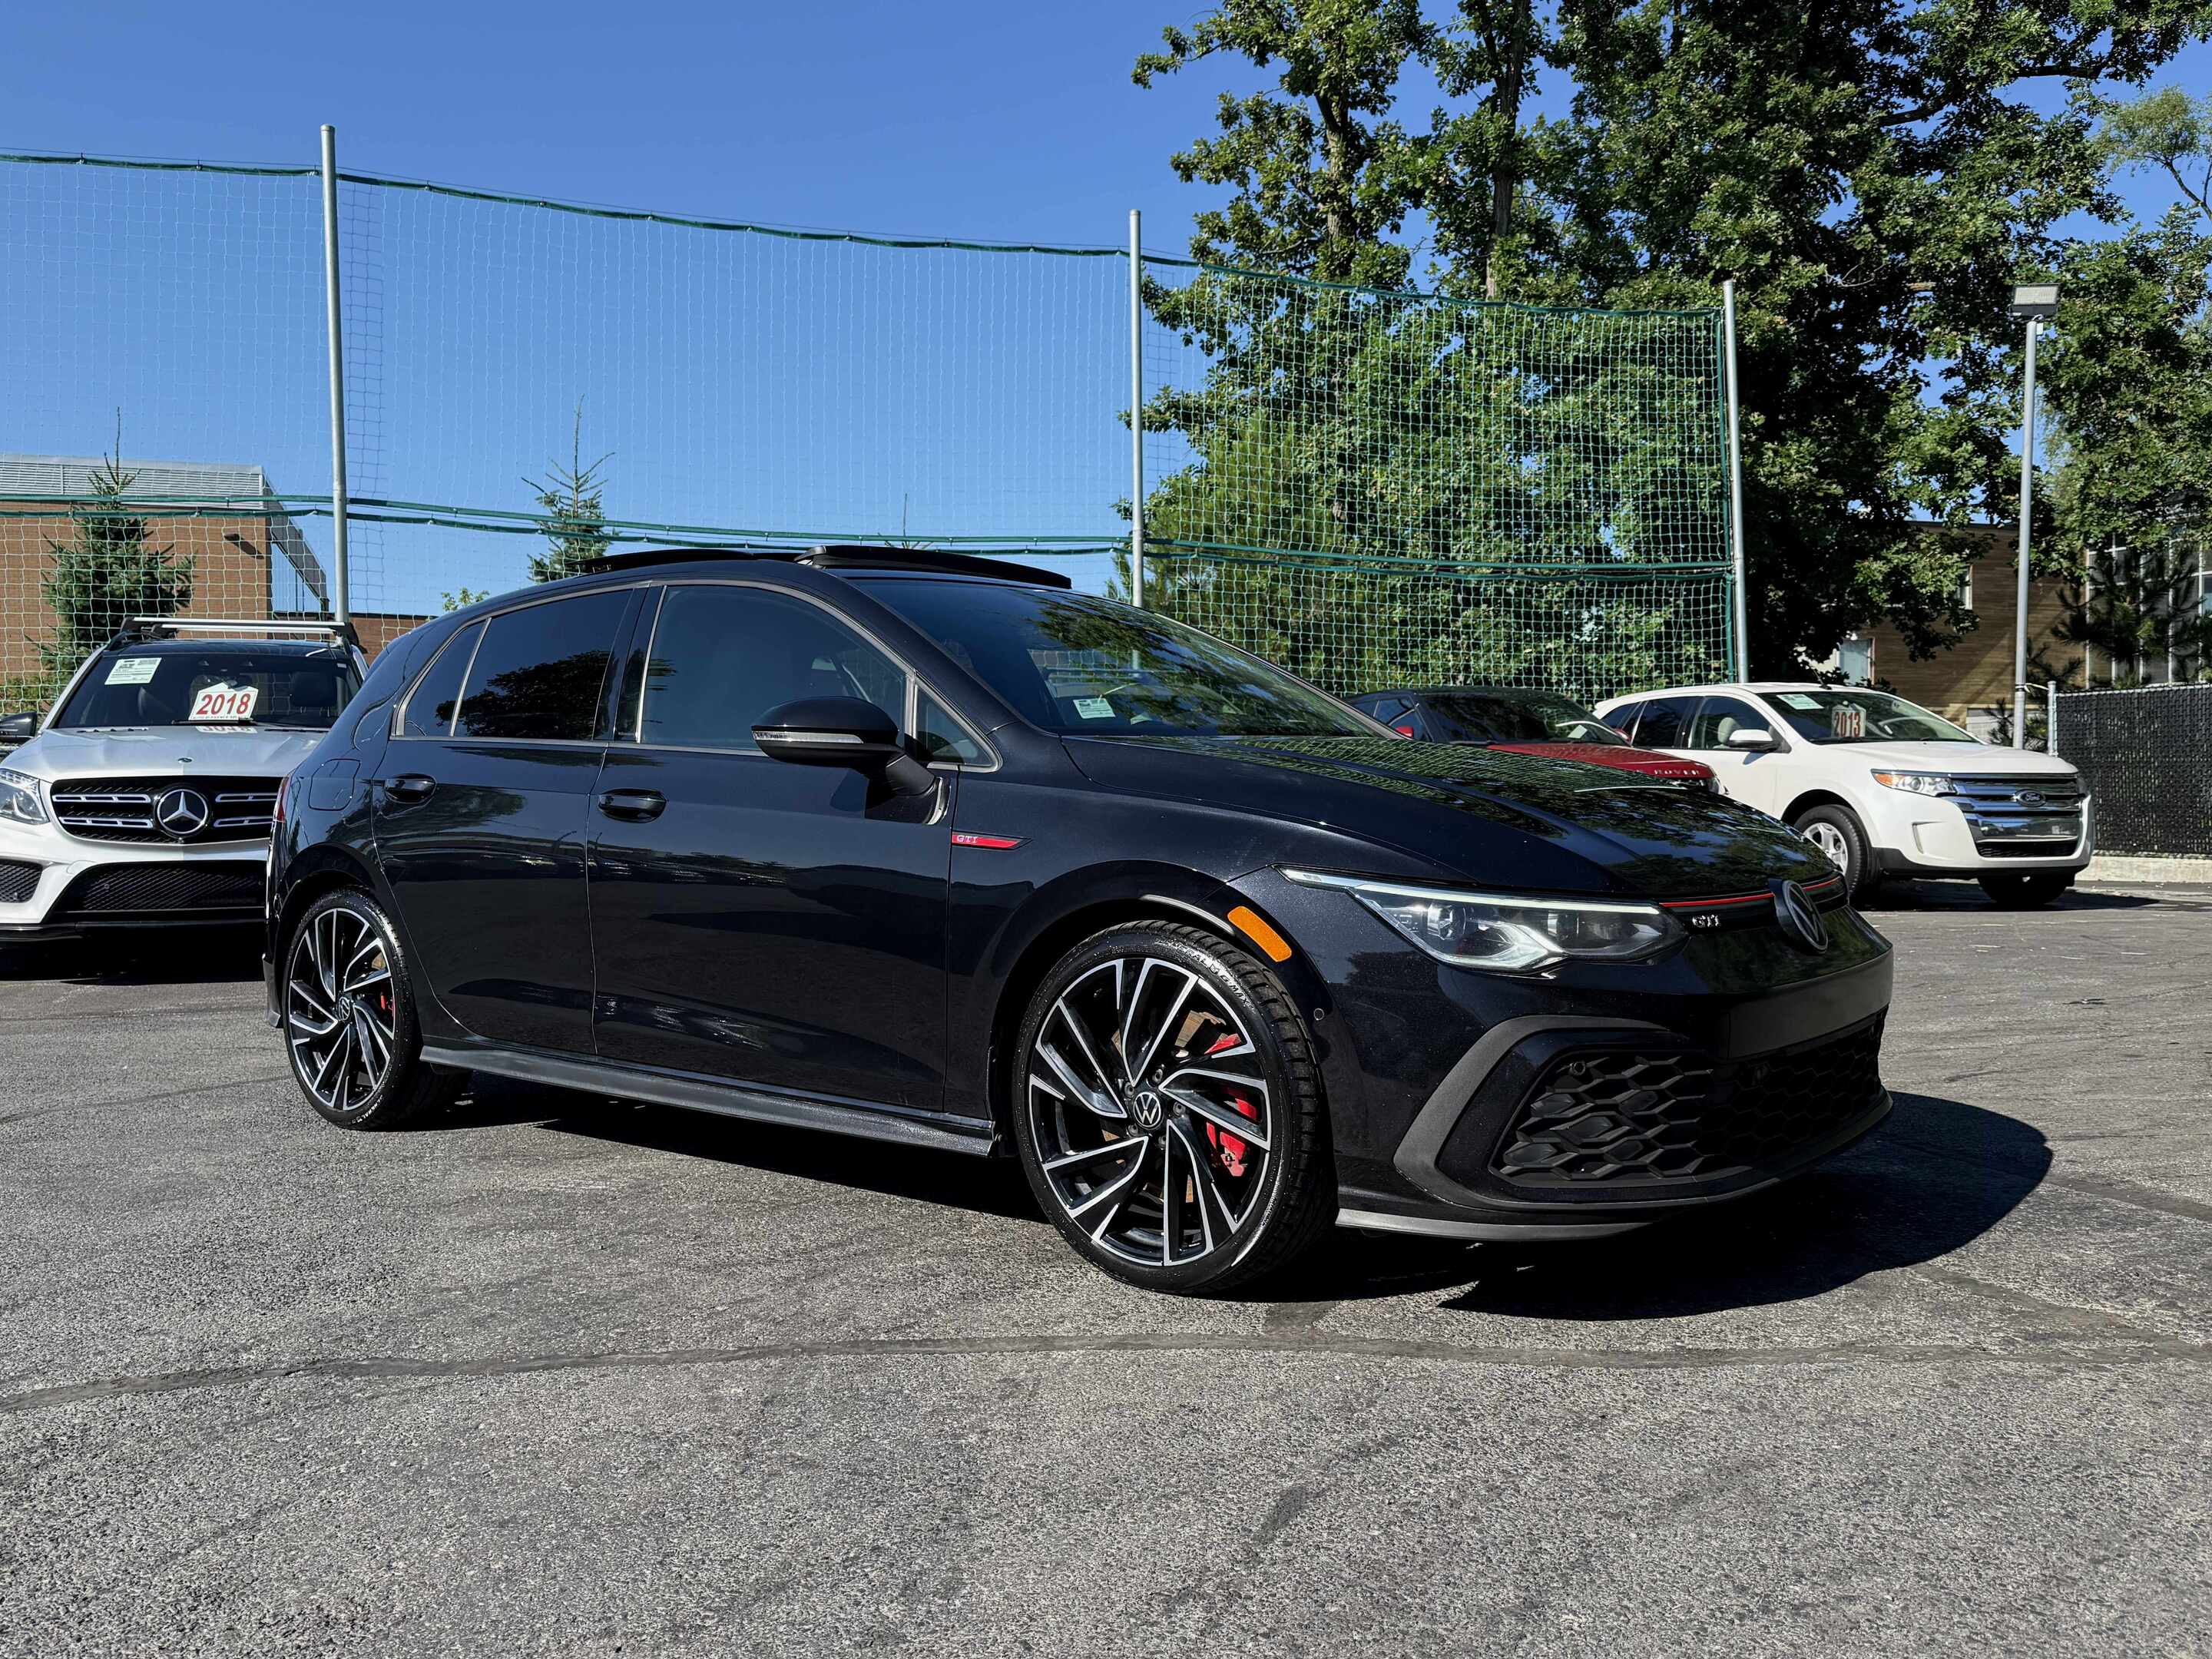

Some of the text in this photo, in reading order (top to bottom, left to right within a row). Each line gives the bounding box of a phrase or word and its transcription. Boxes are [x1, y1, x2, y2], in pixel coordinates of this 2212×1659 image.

[197, 694, 251, 715] 2018
[1834, 711, 1860, 737] 2013
[956, 835, 978, 843] GTI
[1692, 915, 1720, 928] GTI
[1134, 1091, 1161, 1127] VW
